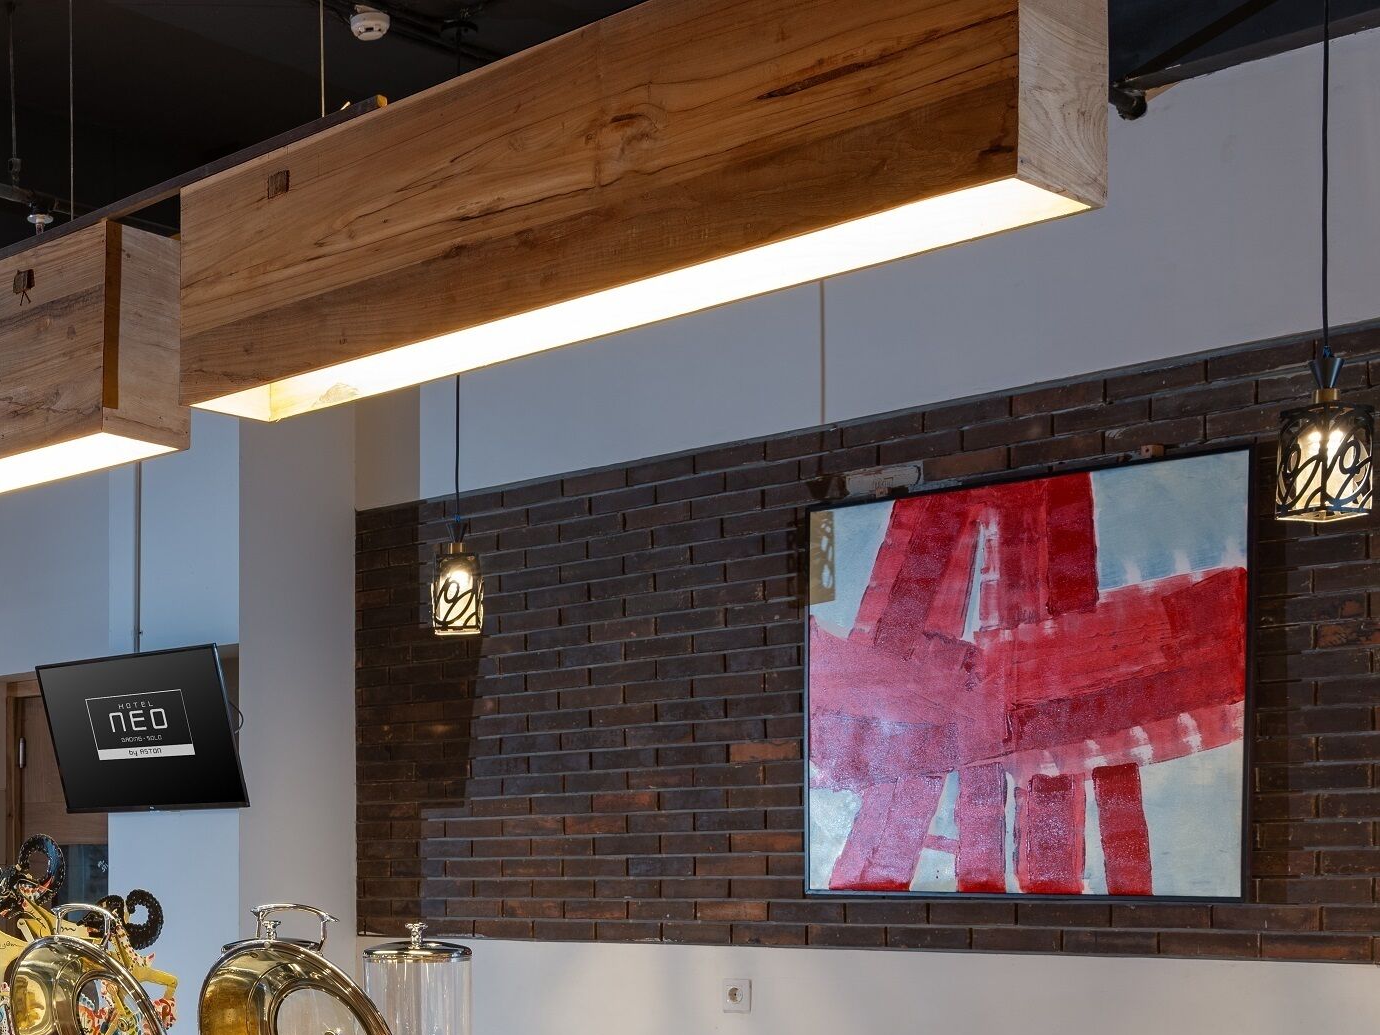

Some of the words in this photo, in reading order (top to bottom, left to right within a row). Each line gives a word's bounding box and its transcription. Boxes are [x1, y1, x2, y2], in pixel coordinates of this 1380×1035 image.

[118, 701, 154, 710] HOTEL
[108, 708, 168, 733] NEO
[128, 749, 138, 757] by
[139, 747, 162, 755] ASTON
